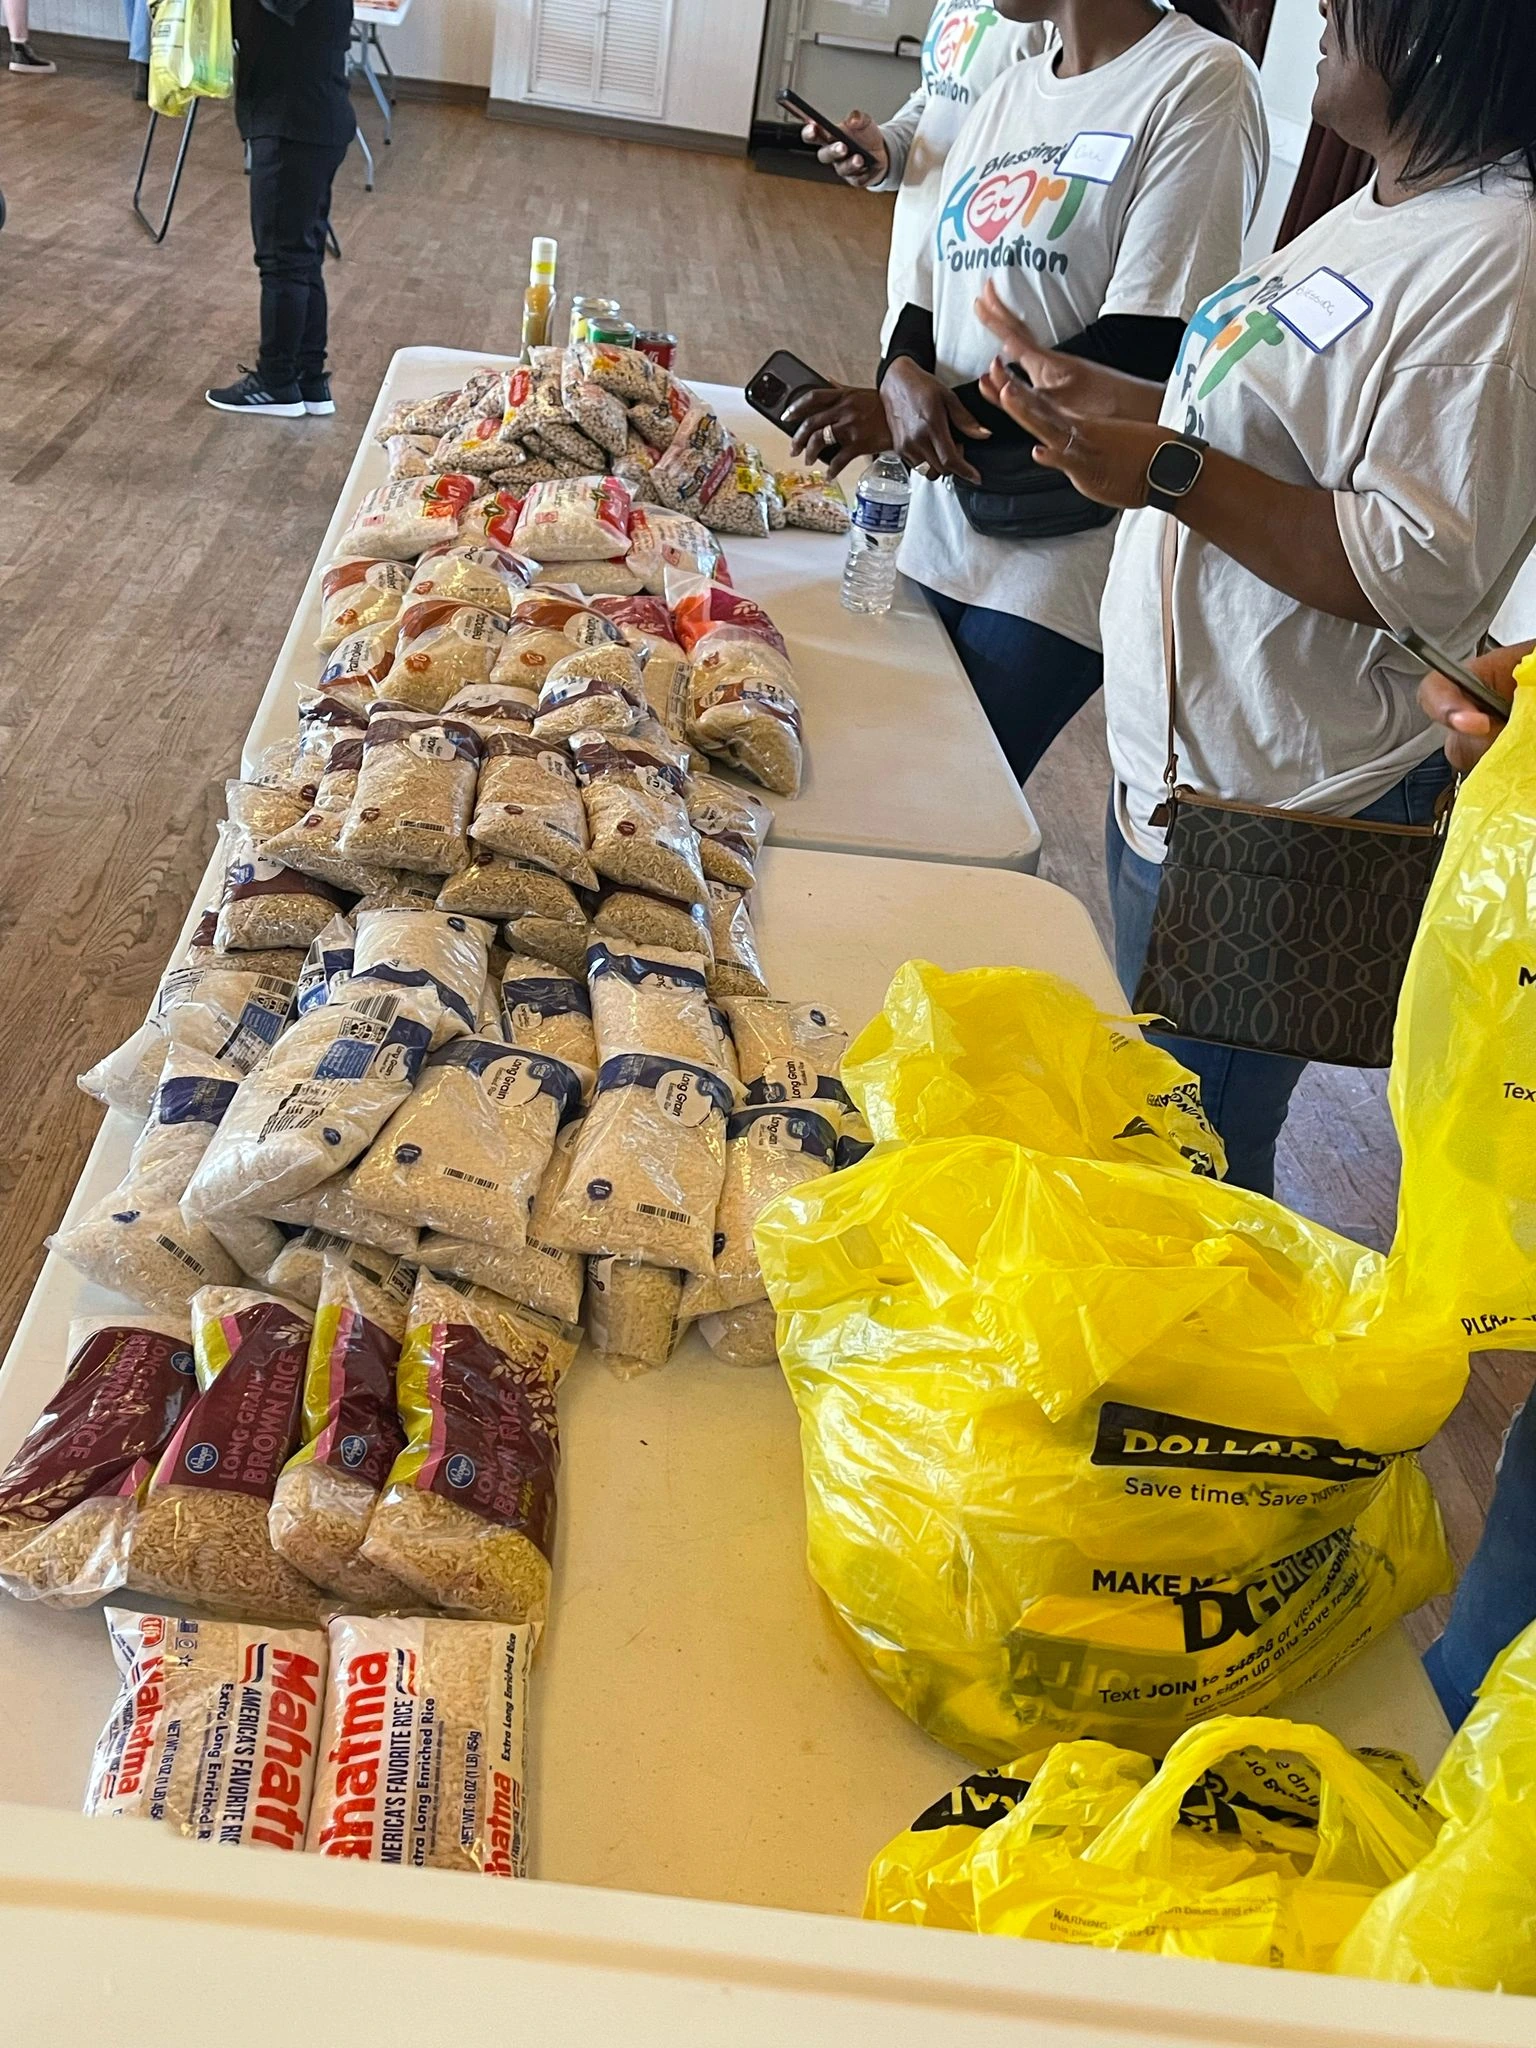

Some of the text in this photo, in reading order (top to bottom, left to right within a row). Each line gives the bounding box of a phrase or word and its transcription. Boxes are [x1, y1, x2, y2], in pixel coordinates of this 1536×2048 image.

[496, 1076, 516, 1100] Grain
[672, 1072, 694, 1117] Long Grain
[785, 1060, 801, 1099] Long Grain
[766, 1115, 783, 1134] Long
[242, 1350, 301, 1485] BROWN RICE
[219, 1430, 250, 1481] LONG
[1122, 1428, 1318, 1461] DOLLAR
[1124, 1477, 1181, 1499] Save
[1258, 1490, 1308, 1508] Save
[1092, 1569, 1181, 1597] MAKE
[1099, 1687, 1141, 1704] Text
[1146, 1679, 1197, 1698] JOIN
[1202, 1675, 1220, 1687] to
[1278, 1625, 1292, 1643] or
[1193, 1694, 1212, 1707] to
[1252, 1658, 1271, 1678] up
[216, 1683, 234, 1721] Extra
[393, 1697, 414, 1728] RICE
[421, 1698, 435, 1724] Rice
[501, 1632, 517, 1762] Extra Long Enriched Rice
[236, 1686, 262, 1757] AMERICA'S
[207, 1724, 230, 1758] Long
[416, 1727, 433, 1789] Enriched
[386, 1731, 412, 1797] FAVORITE
[464, 1773, 478, 1790] OZ
[199, 1762, 222, 1826] Enriched
[222, 1756, 254, 1822] FAVORITE
[464, 1789, 477, 1801] 16
[412, 1795, 433, 1832] Long
